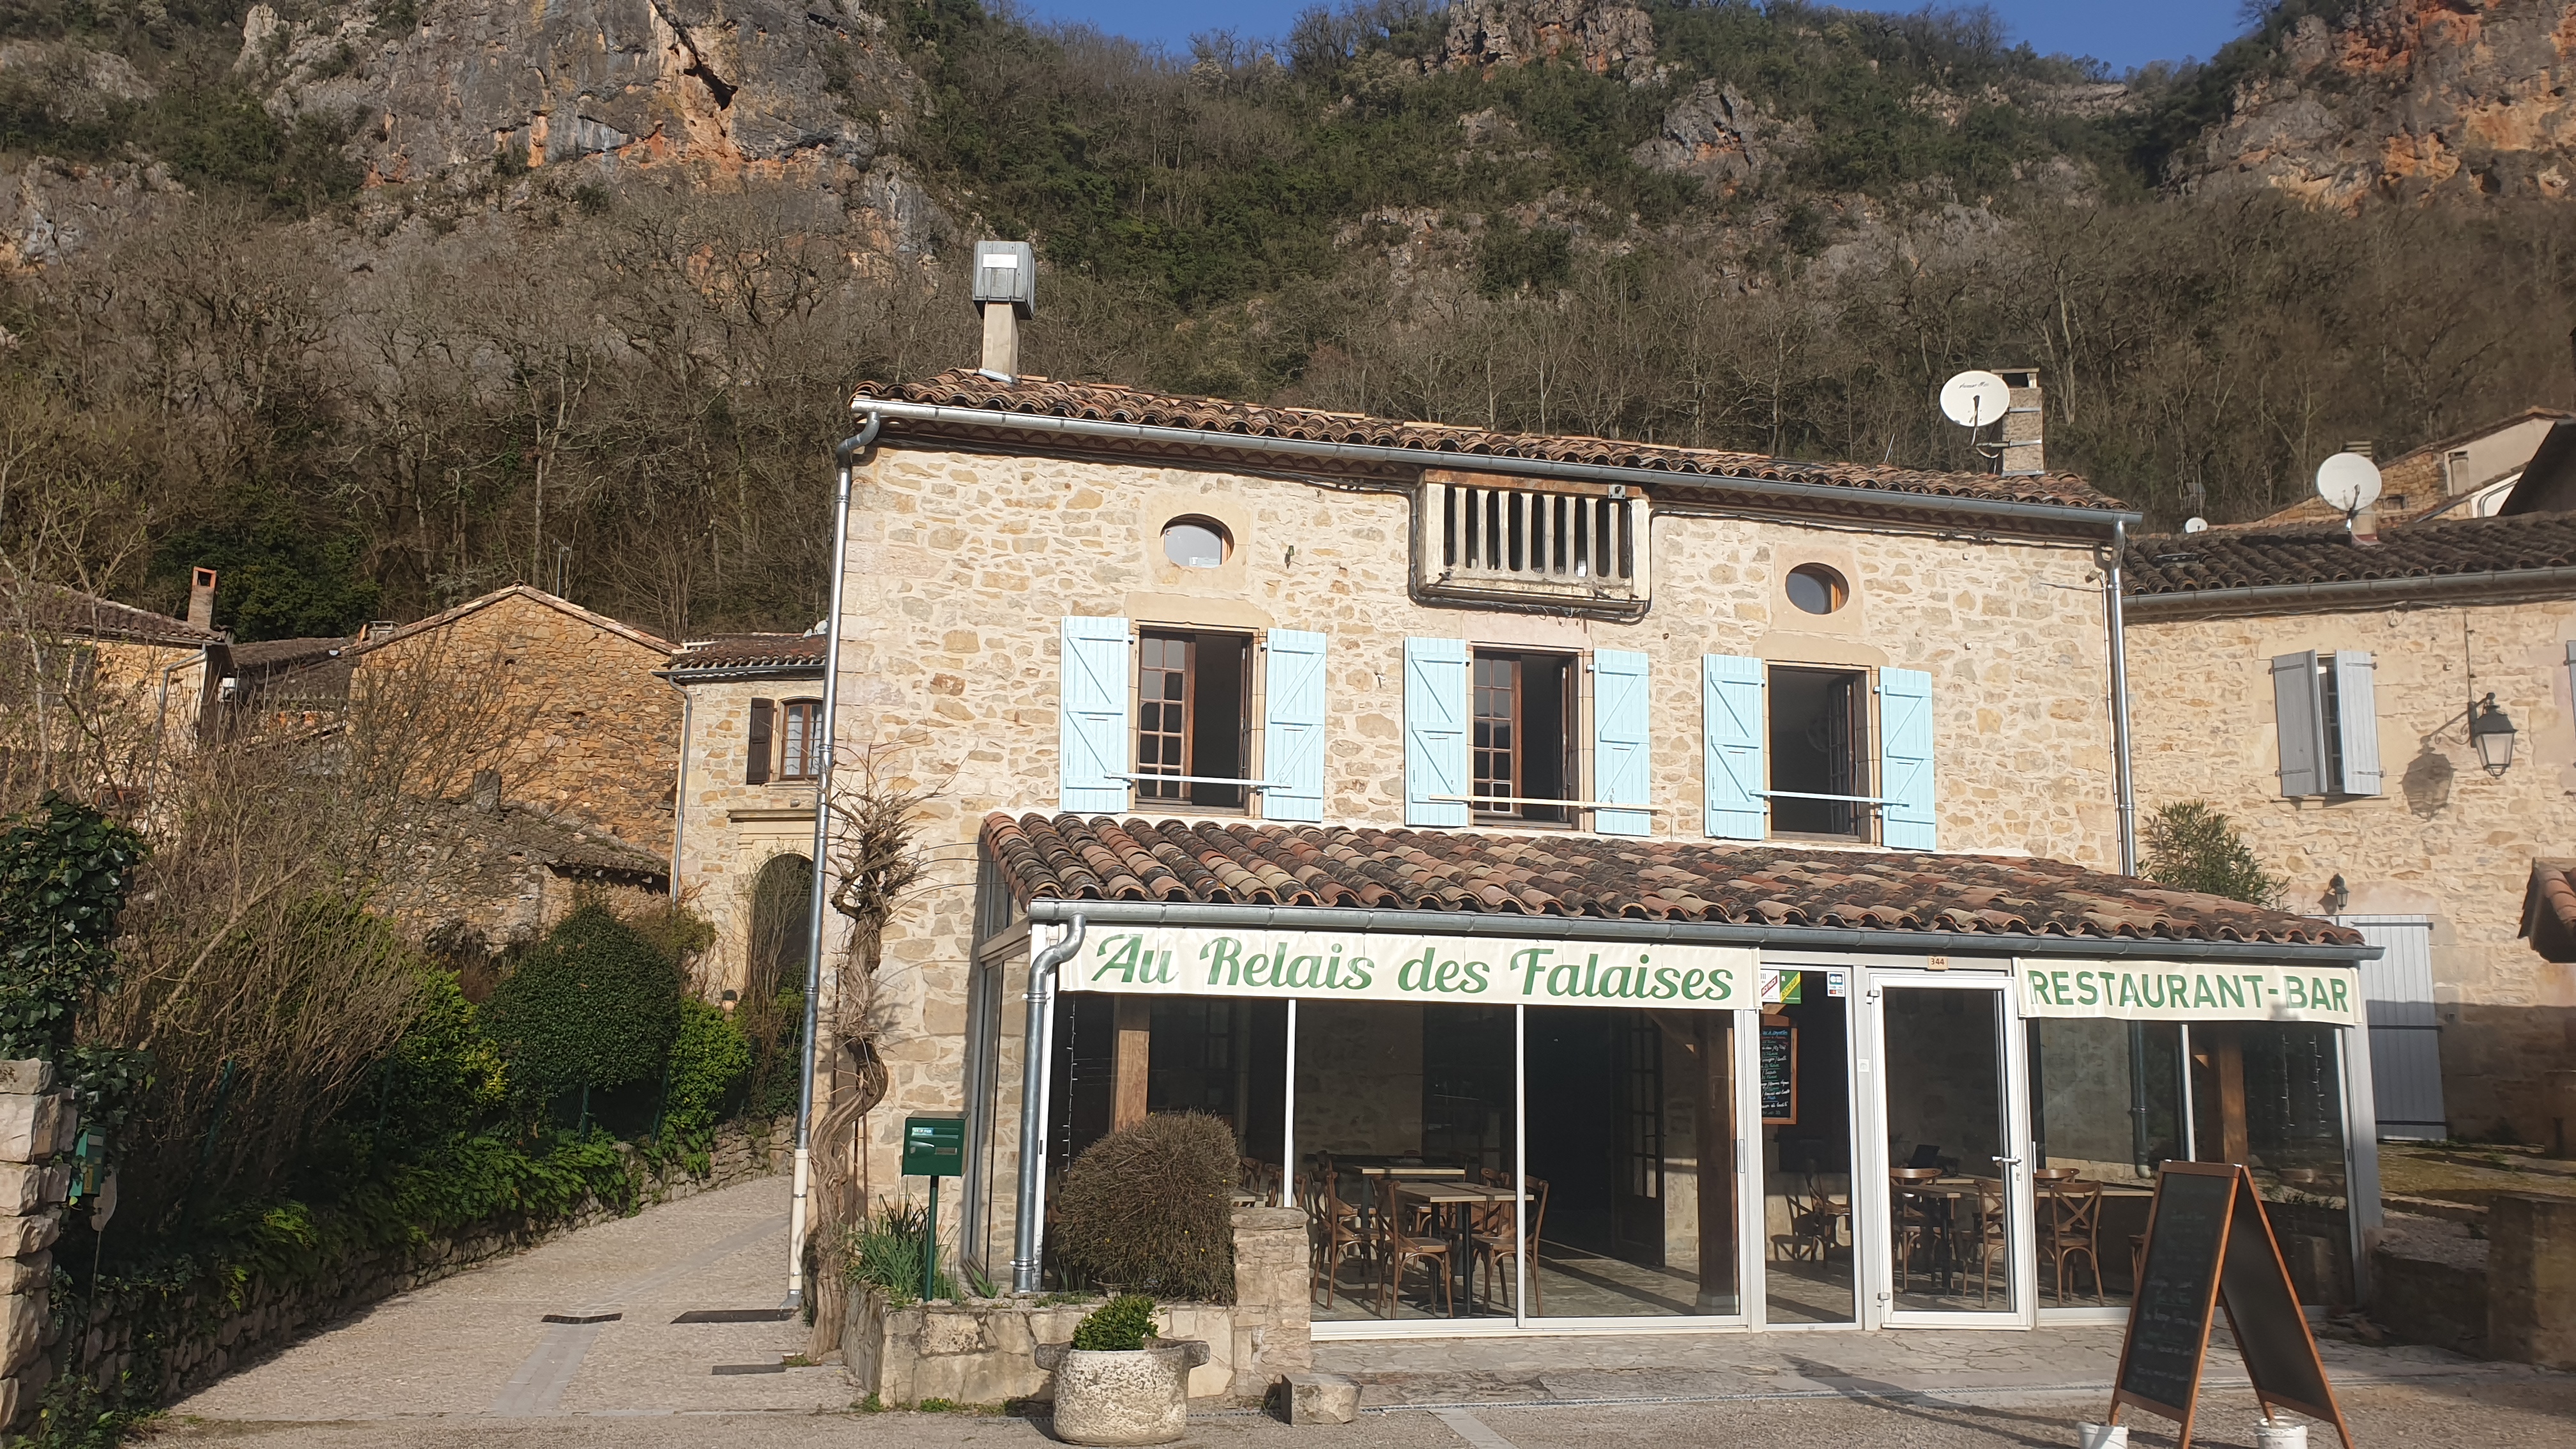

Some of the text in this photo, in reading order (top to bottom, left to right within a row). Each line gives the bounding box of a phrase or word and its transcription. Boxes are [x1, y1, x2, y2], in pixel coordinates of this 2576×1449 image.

[1091, 933, 1733, 1000] Au Relais des Falaises
[2027, 969, 2350, 1013] RESTAURANT-BAR
